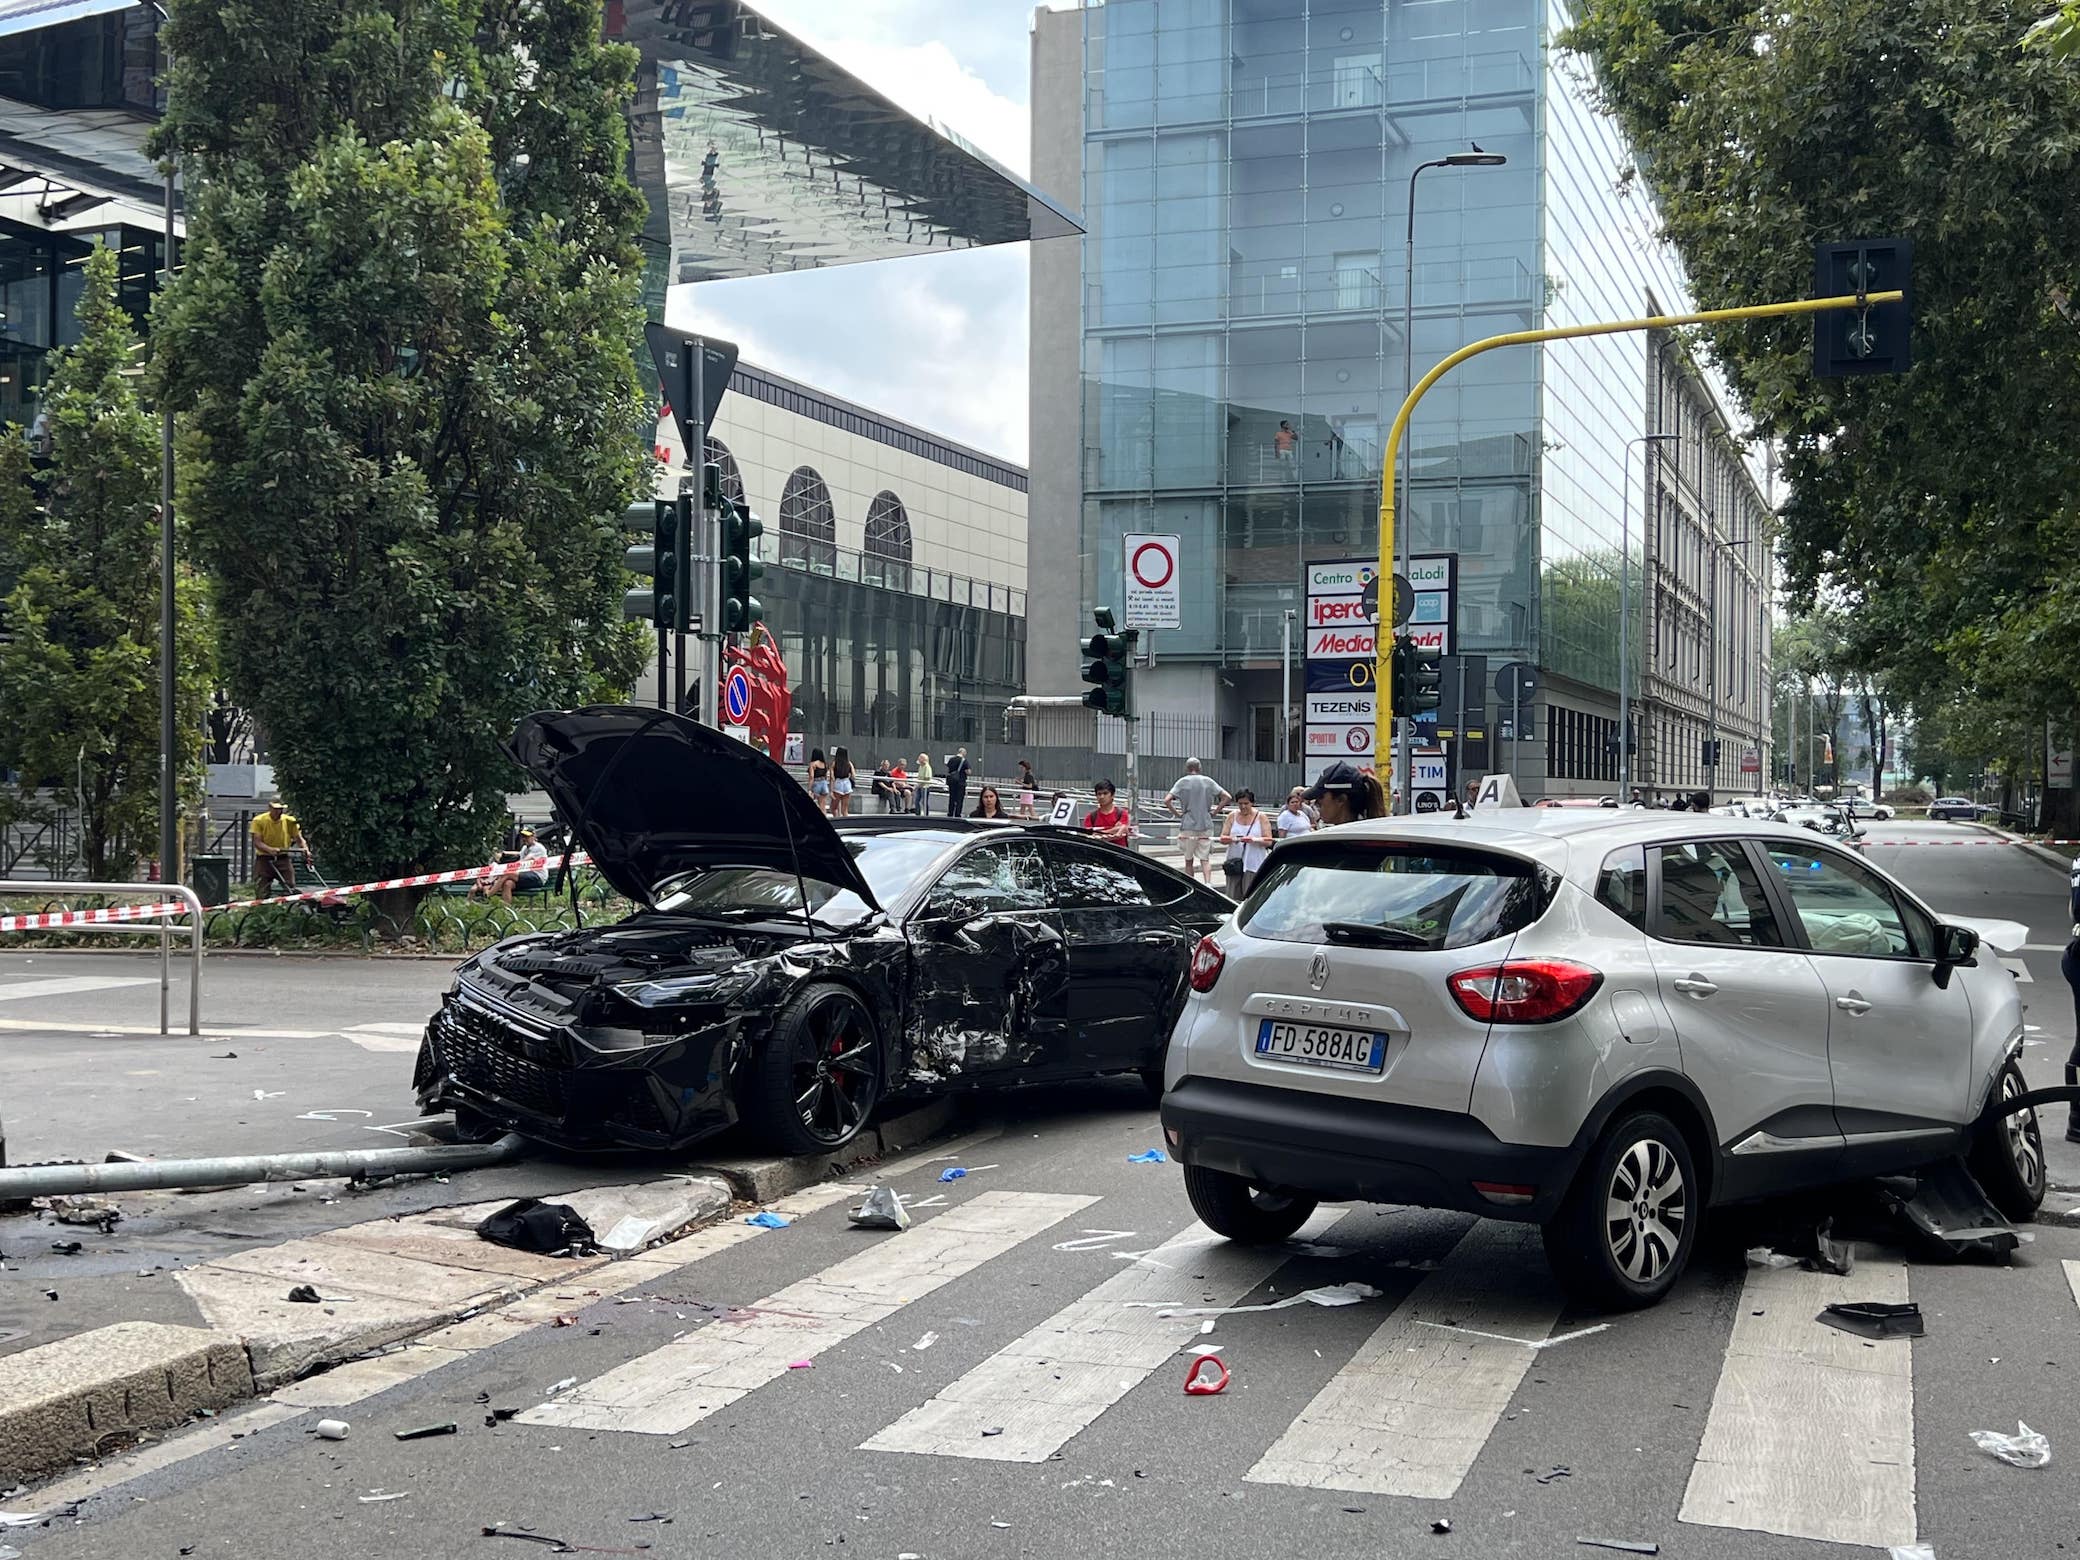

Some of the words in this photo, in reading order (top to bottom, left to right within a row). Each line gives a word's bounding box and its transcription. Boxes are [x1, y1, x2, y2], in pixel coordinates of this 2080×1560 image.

[1314, 572, 1353, 585] Centro
[1311, 699, 1371, 713] TEZENIS
[1419, 766, 1443, 778] TIM
[1478, 780, 1499, 803] A
[1054, 803, 1071, 819] B
[1266, 1000, 1370, 1021] CAPTUR
[1270, 1026, 1296, 1052] FD
[1302, 1029, 1369, 1062] 588AG
